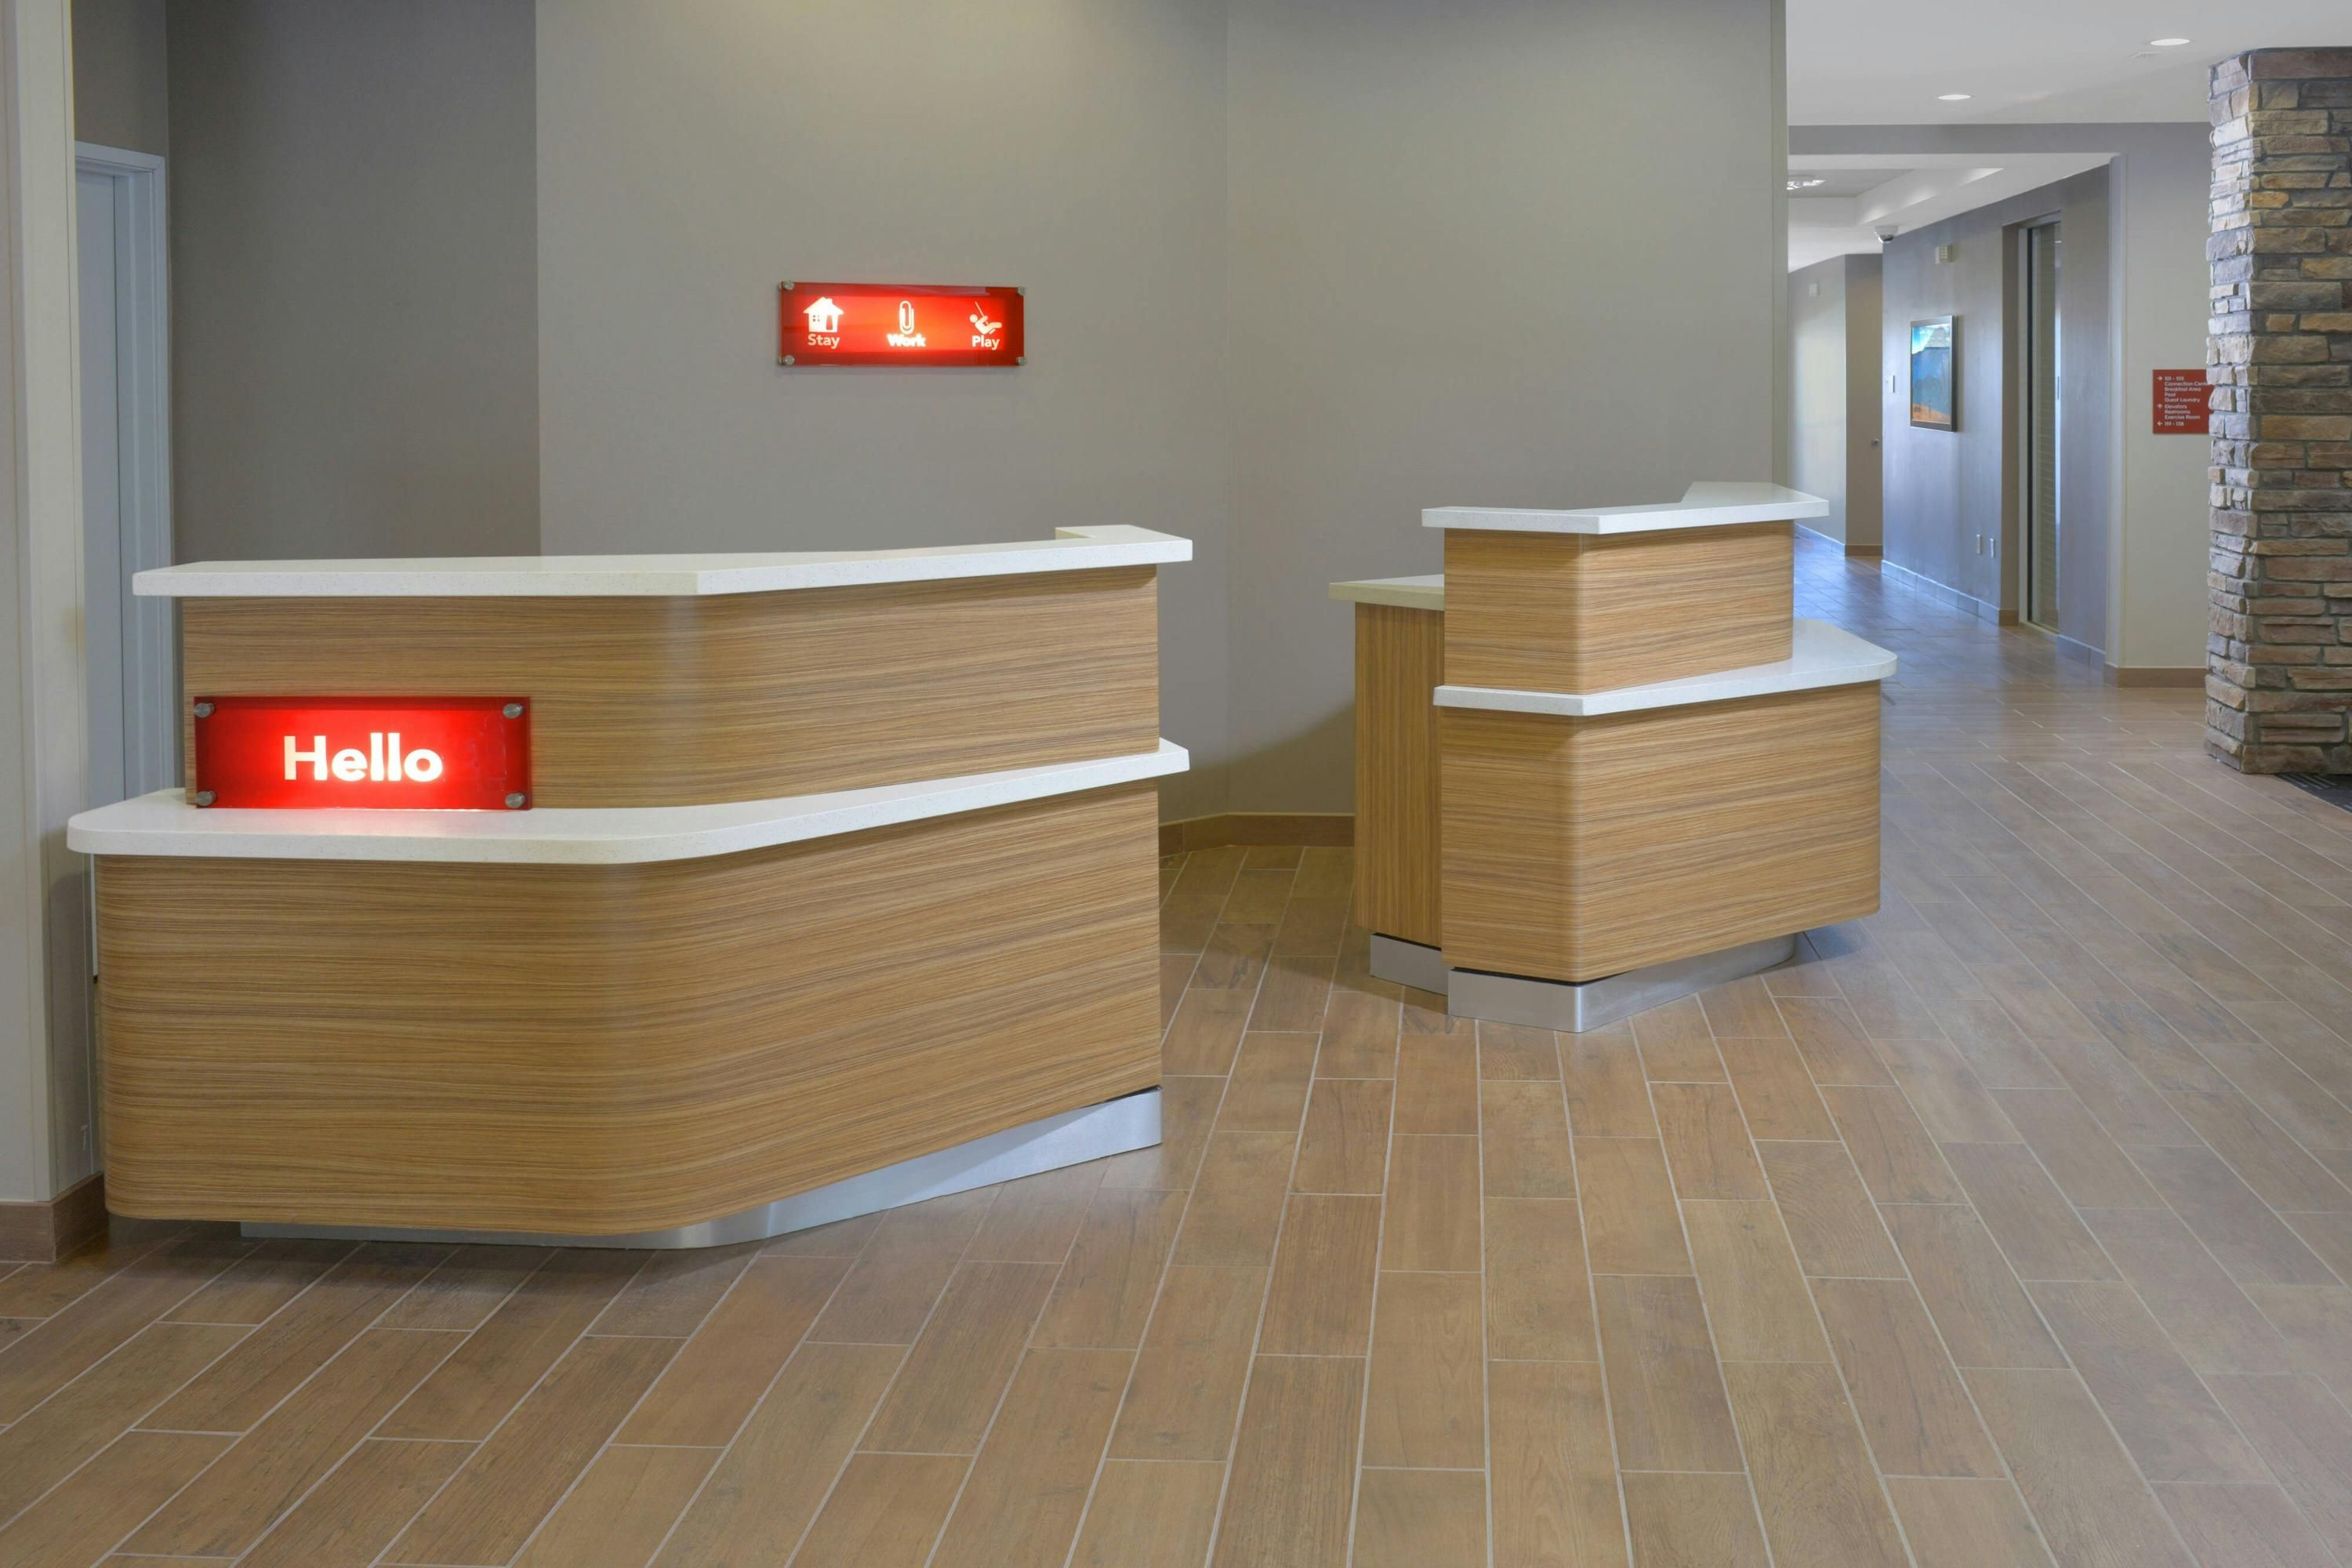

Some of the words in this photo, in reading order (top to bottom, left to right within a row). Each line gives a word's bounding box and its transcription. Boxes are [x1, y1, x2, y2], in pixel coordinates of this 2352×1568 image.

[808, 333, 840, 349] Stay
[887, 333, 926, 347] Work
[971, 335, 1000, 350] Play
[284, 731, 444, 782] Hello
